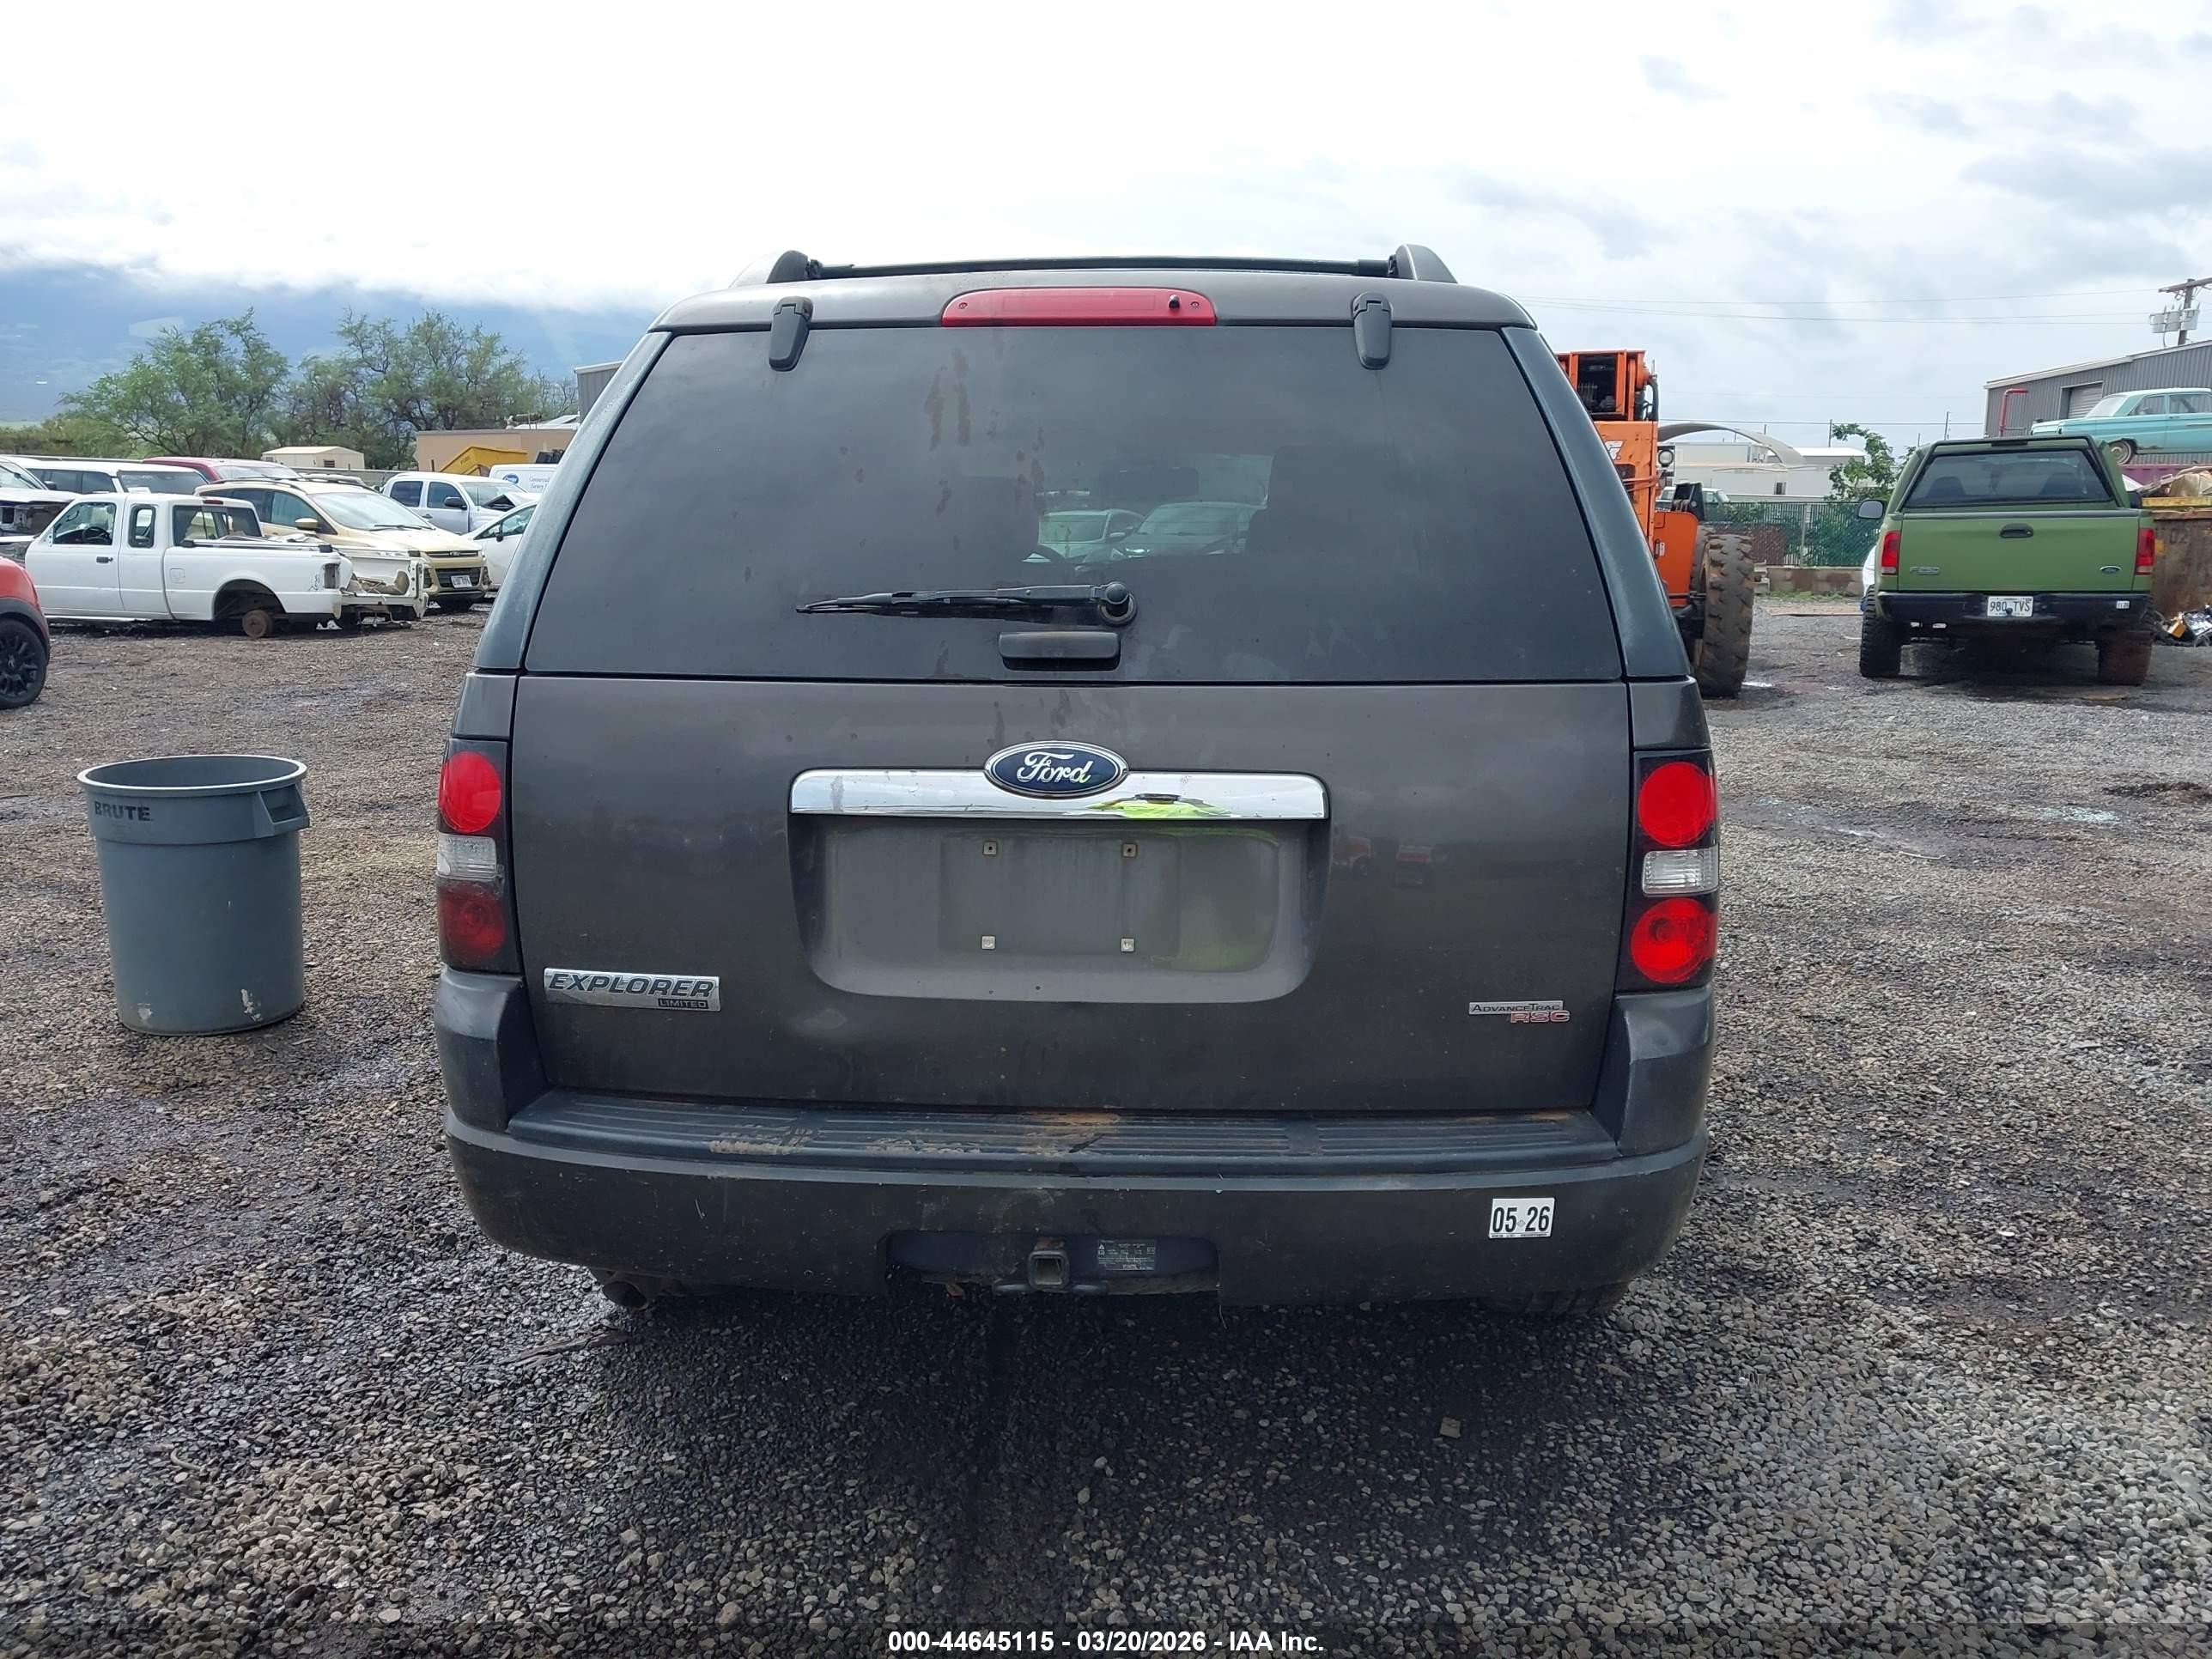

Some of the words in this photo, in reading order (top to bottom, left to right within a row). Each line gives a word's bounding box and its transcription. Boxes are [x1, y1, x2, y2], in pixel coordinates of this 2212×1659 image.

[1990, 601, 2008, 612] 980
[2013, 601, 2031, 612] TVS
[1017, 751, 1094, 784] Ford
[94, 801, 152, 822] BRUTE
[548, 973, 716, 998] EXPLORER
[659, 999, 708, 1010] LIMITED
[1510, 1010, 1571, 1024] RSC
[1492, 1206, 1518, 1233] 05
[1524, 1206, 1551, 1232] 26
